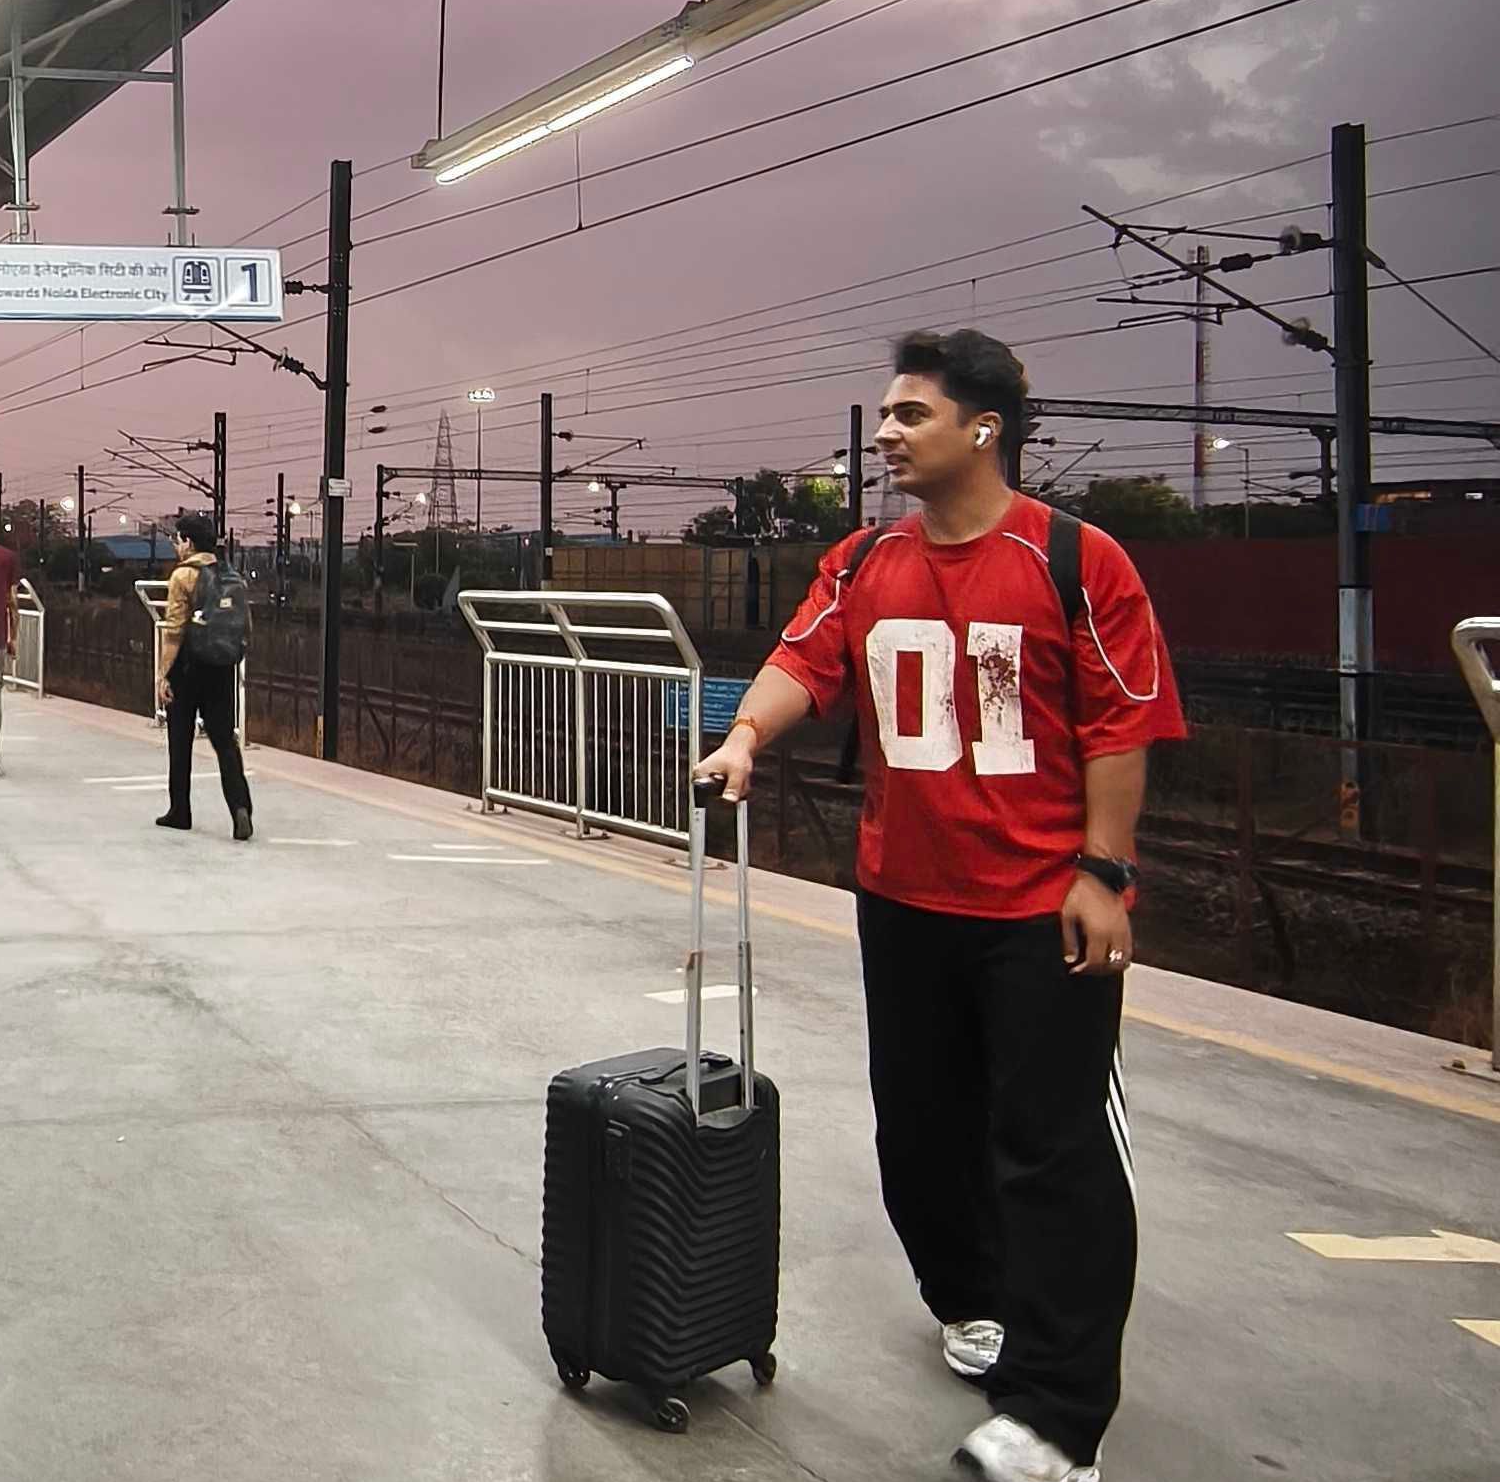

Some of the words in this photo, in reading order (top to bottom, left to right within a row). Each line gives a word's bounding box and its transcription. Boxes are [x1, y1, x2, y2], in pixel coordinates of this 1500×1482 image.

[99, 261, 126, 277] सिटी
[128, 262, 144, 277] की
[147, 262, 168, 278] ओर
[241, 263, 258, 302] 1
[43, 287, 78, 299] Noida
[81, 288, 140, 300] Electronic
[144, 288, 169, 302] City
[866, 619, 1037, 775] 01
